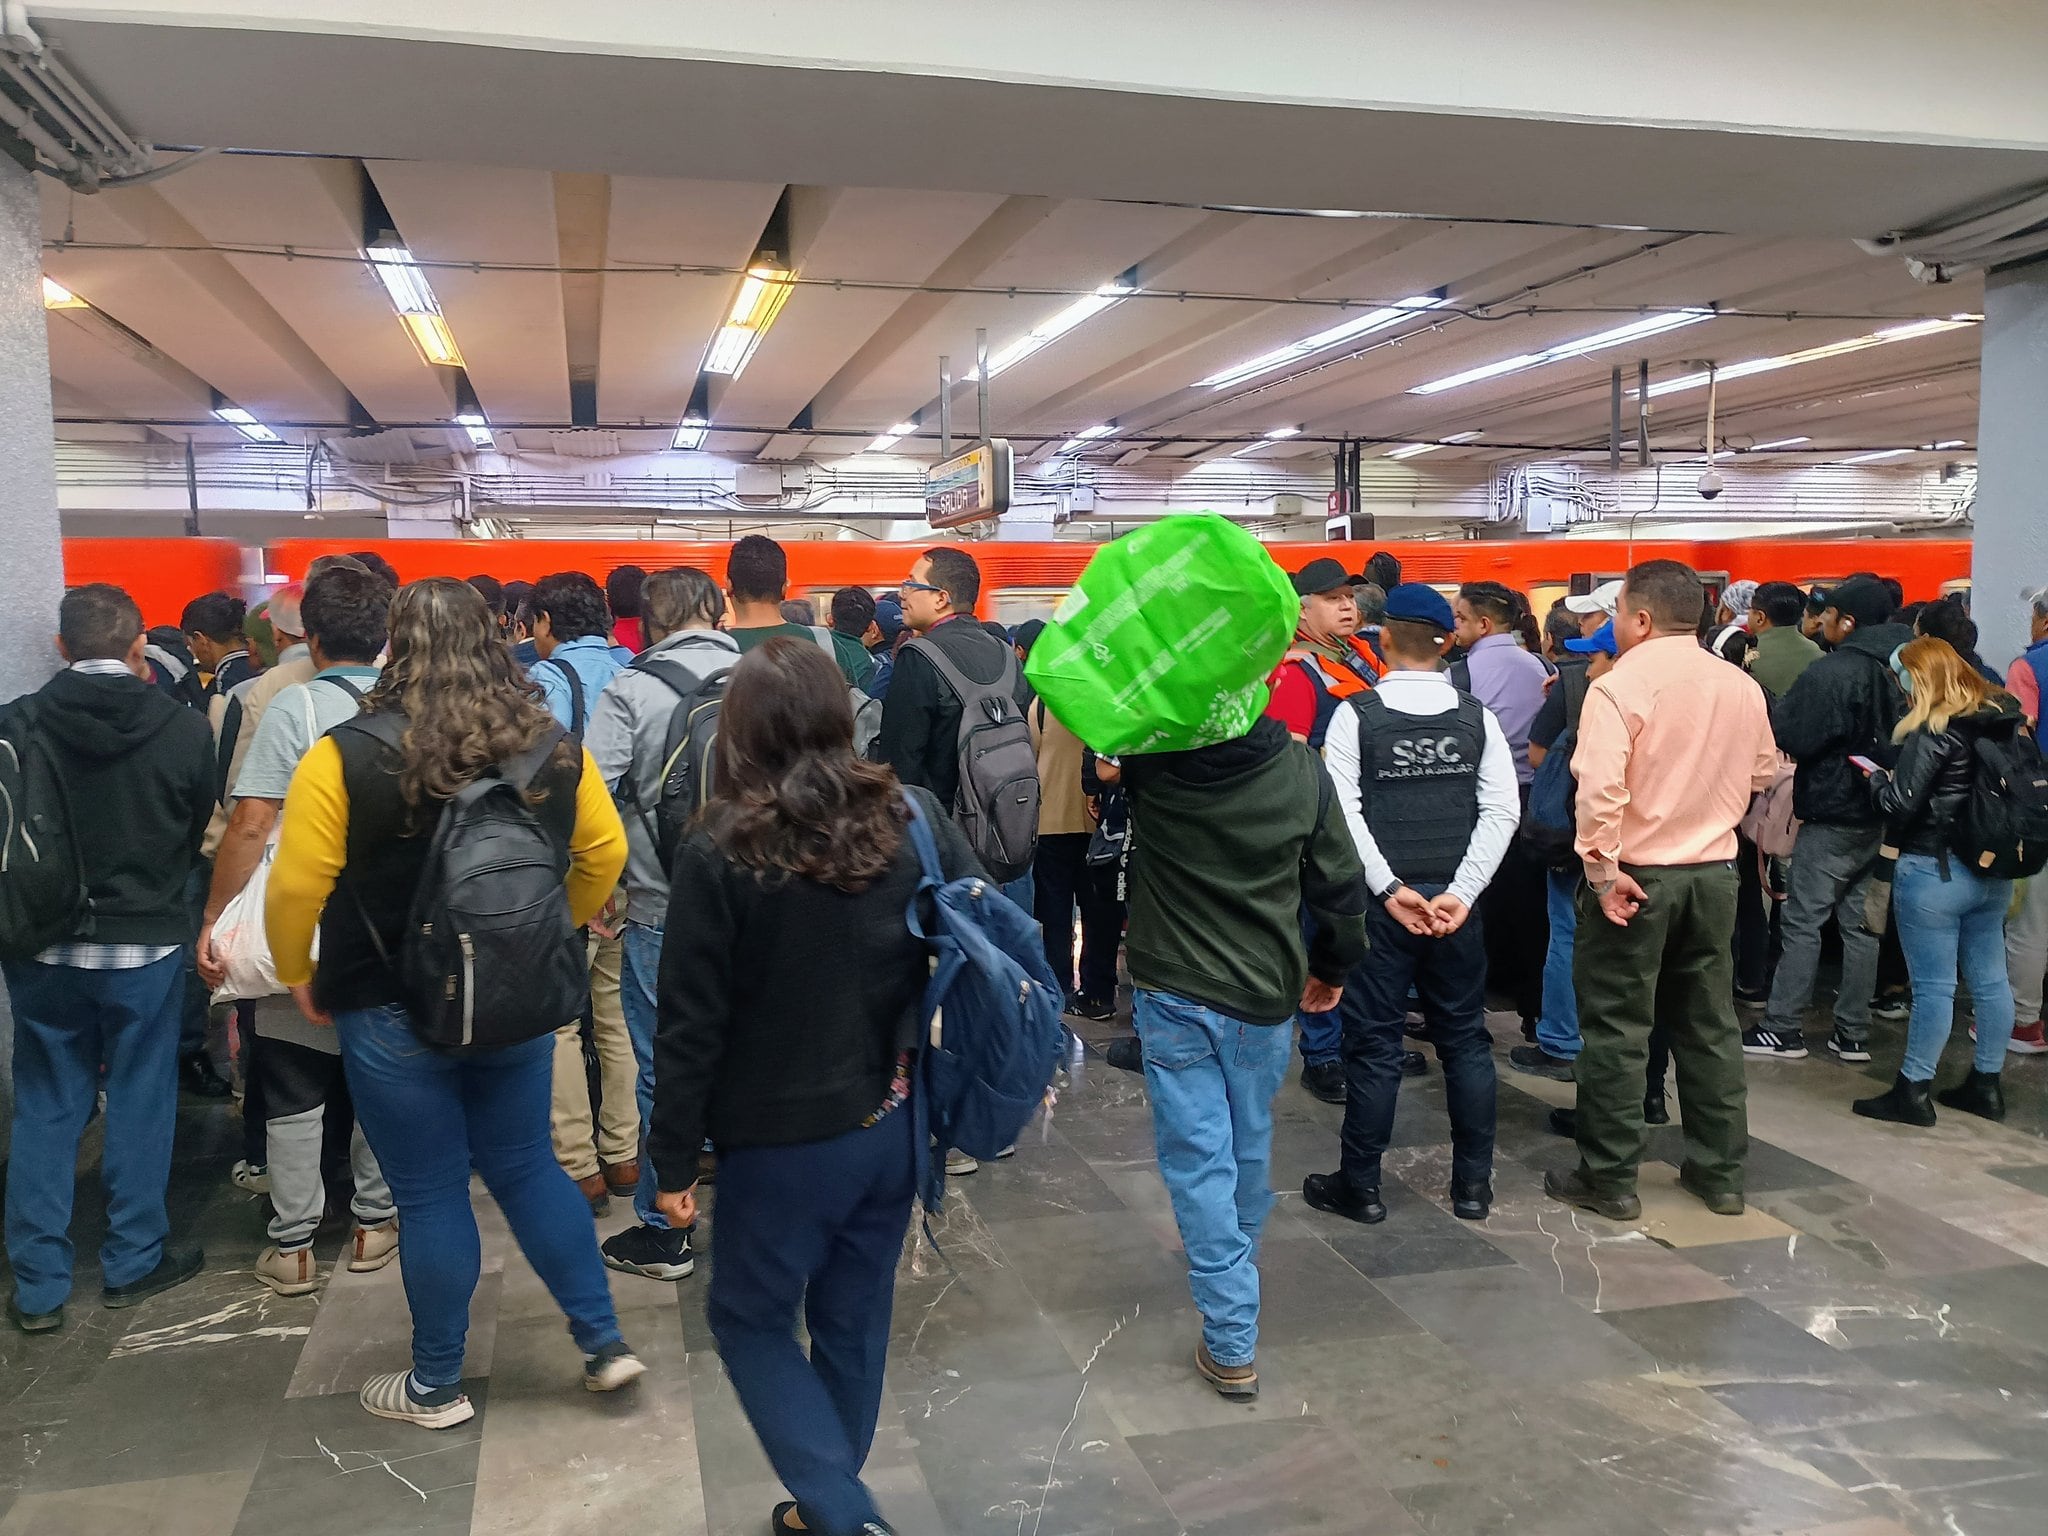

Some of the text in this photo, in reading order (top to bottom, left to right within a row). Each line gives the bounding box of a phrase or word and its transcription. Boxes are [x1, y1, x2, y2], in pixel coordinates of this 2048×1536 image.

[941, 489, 968, 515] SALIDA
[1391, 736, 1461, 767] SSC
[1123, 818, 1132, 851] adidas
